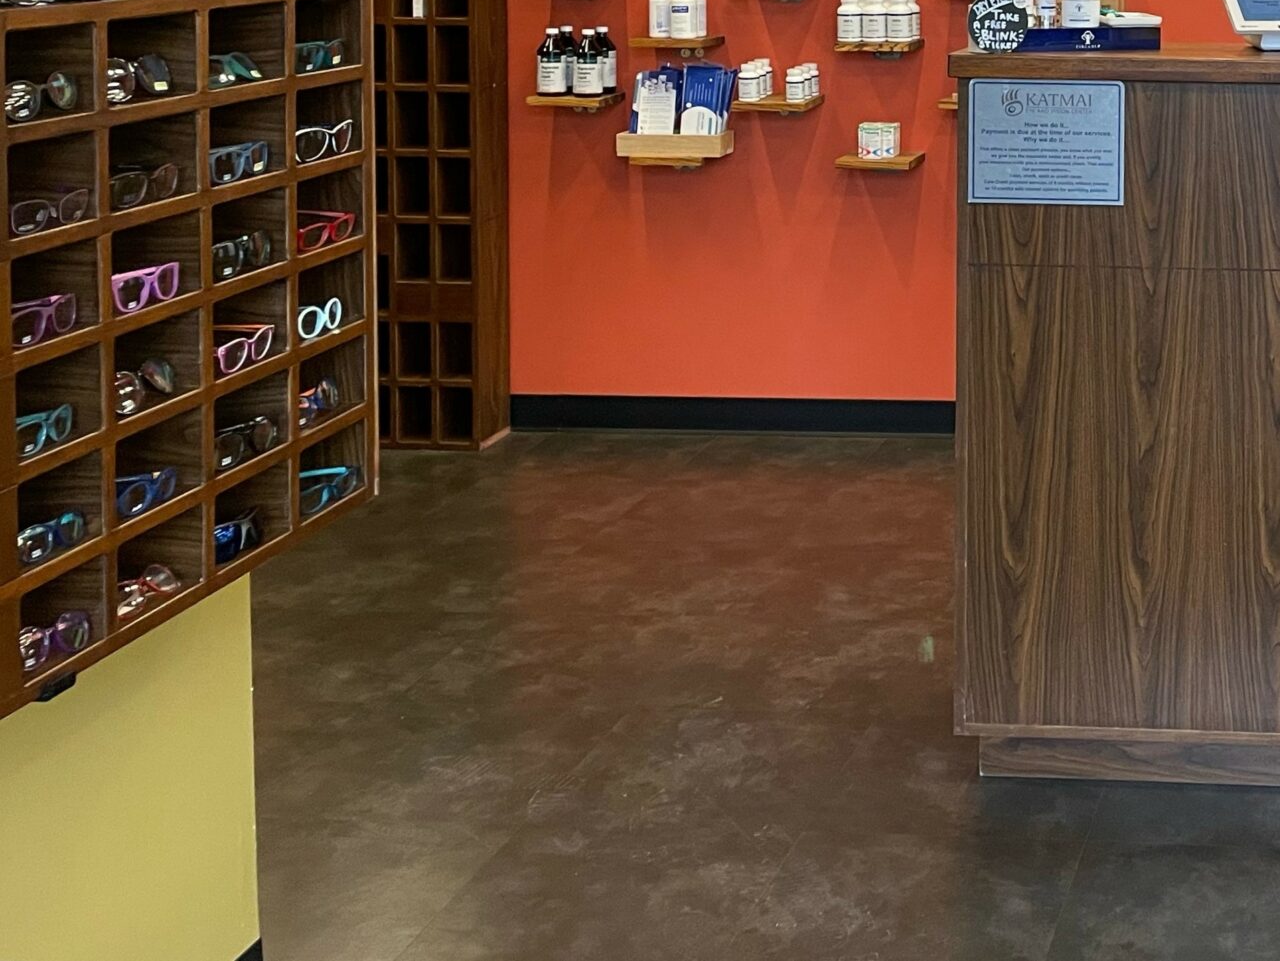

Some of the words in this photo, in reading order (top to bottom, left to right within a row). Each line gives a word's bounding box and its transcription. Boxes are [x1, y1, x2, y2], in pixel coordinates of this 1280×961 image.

[973, 0, 989, 15] DRY
[984, 20, 1007, 30] FREE
[981, 29, 1018, 41] BLINK
[979, 41, 1018, 50] STICKER
[1026, 93, 1092, 107] KATMAI
